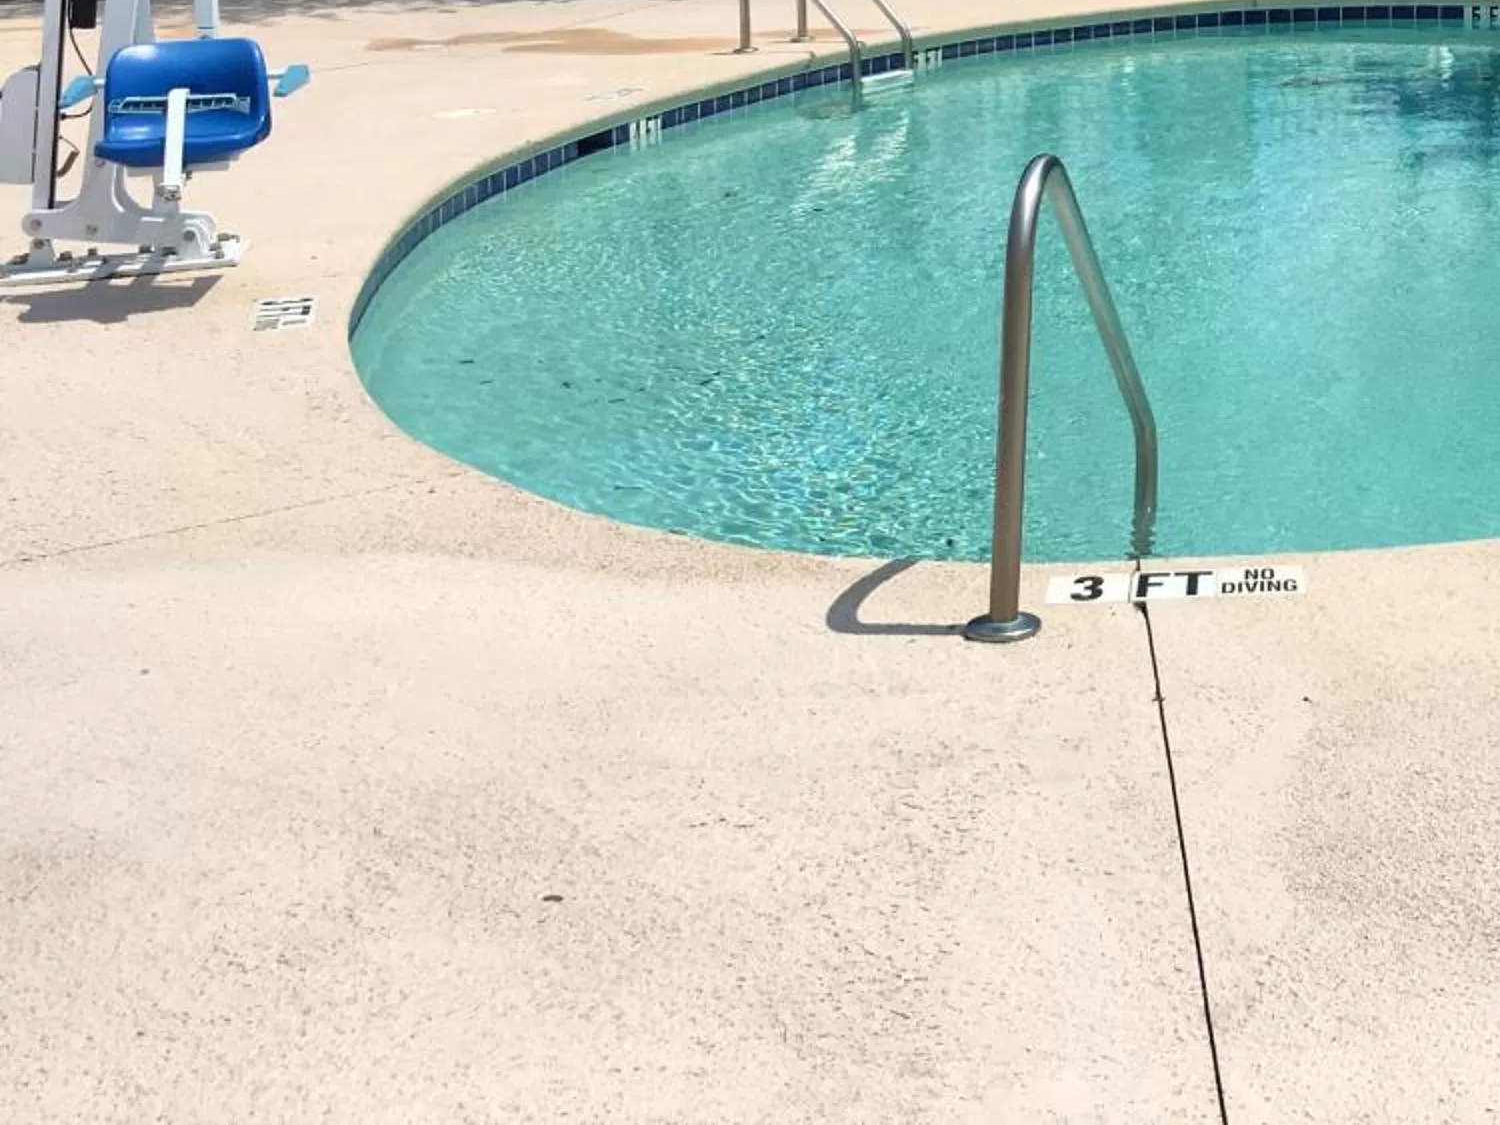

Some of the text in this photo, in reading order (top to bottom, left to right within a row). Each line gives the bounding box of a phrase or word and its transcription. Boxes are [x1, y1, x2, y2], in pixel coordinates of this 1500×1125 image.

[1244, 568, 1275, 580] NO
[1070, 571, 1213, 601] 3 FT
[1221, 578, 1298, 594] DIVING
